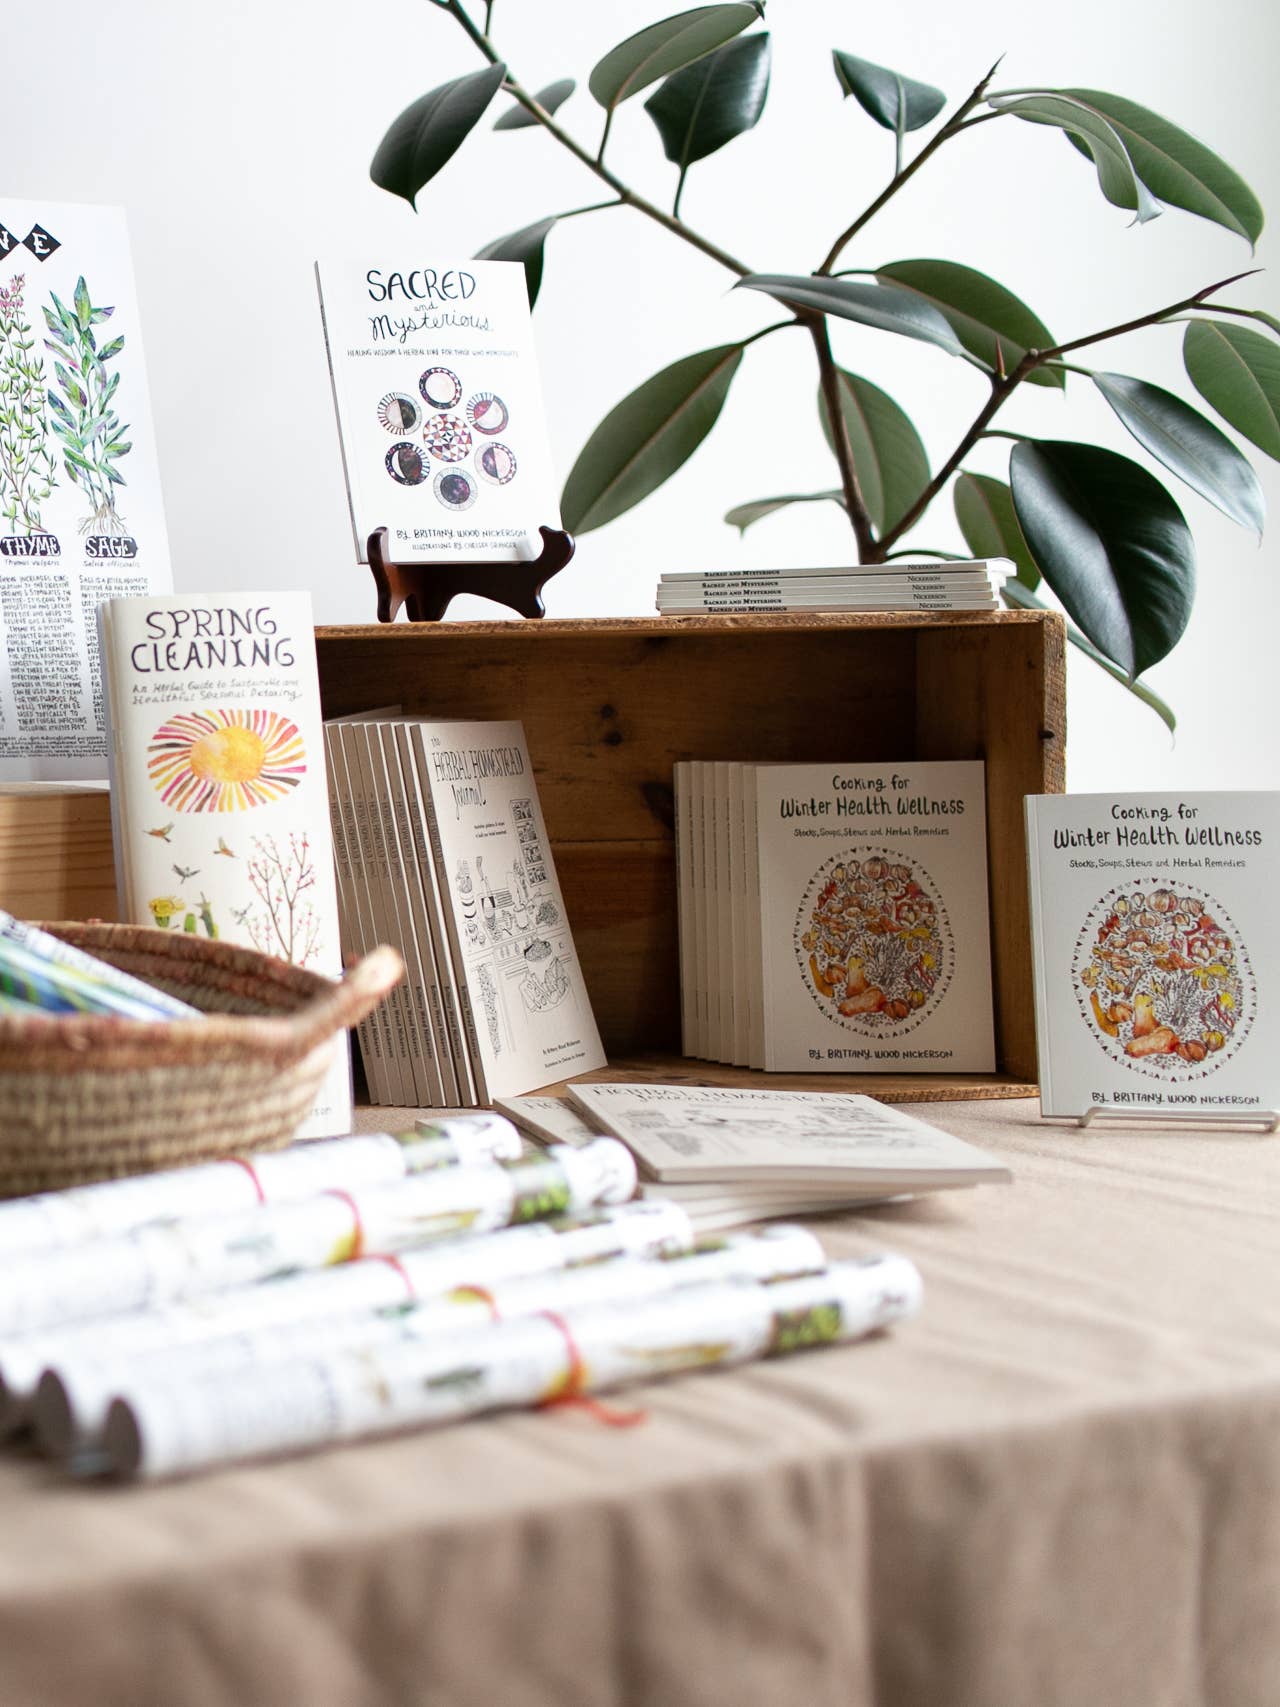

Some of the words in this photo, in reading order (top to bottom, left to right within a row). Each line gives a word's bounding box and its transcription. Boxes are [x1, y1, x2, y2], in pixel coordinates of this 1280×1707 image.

[367, 268, 476, 301] SACRED
[414, 301, 438, 312] and
[368, 310, 494, 344] Mysterious
[414, 529, 453, 539] BRITTANY
[457, 529, 480, 538] WOOD
[482, 529, 526, 538] NICKERSON
[2, 536, 61, 556] THYME
[85, 536, 134, 557] SAGE
[146, 607, 277, 640] SPRING
[131, 638, 295, 673] CLEANING
[187, 680, 214, 690] Guide
[432, 750, 472, 782] HERBAL
[469, 747, 524, 779] HOMESTEAD
[832, 775, 886, 792] Cooking
[891, 774, 910, 790] for
[780, 797, 832, 819] Winter
[837, 796, 892, 816] Health
[897, 797, 965, 815] Wellness
[1111, 804, 1171, 821] Cooking
[1178, 803, 1199, 819] for
[870, 827, 883, 836] and
[885, 826, 911, 836] Herbal
[913, 826, 949, 836] Remedies
[1053, 827, 1111, 849] Winter
[1116, 825, 1179, 847] Health
[1185, 826, 1262, 846] Wellness
[1125, 858, 1153, 868] Stews
[1155, 859, 1169, 868] and
[1173, 857, 1202, 868] Herbal
[1204, 857, 1246, 868] Remedies
[809, 1049, 824, 1060] BY
[827, 1049, 872, 1060] BRITTANY
[874, 1049, 900, 1059] WOOD
[903, 1050, 953, 1059] NICKERSON
[1091, 1092, 1109, 1104] BY
[1113, 1092, 1165, 1105] BRITTANY
[1167, 1095, 1197, 1104] WOOD
[1200, 1095, 1260, 1105] NICKERSON
